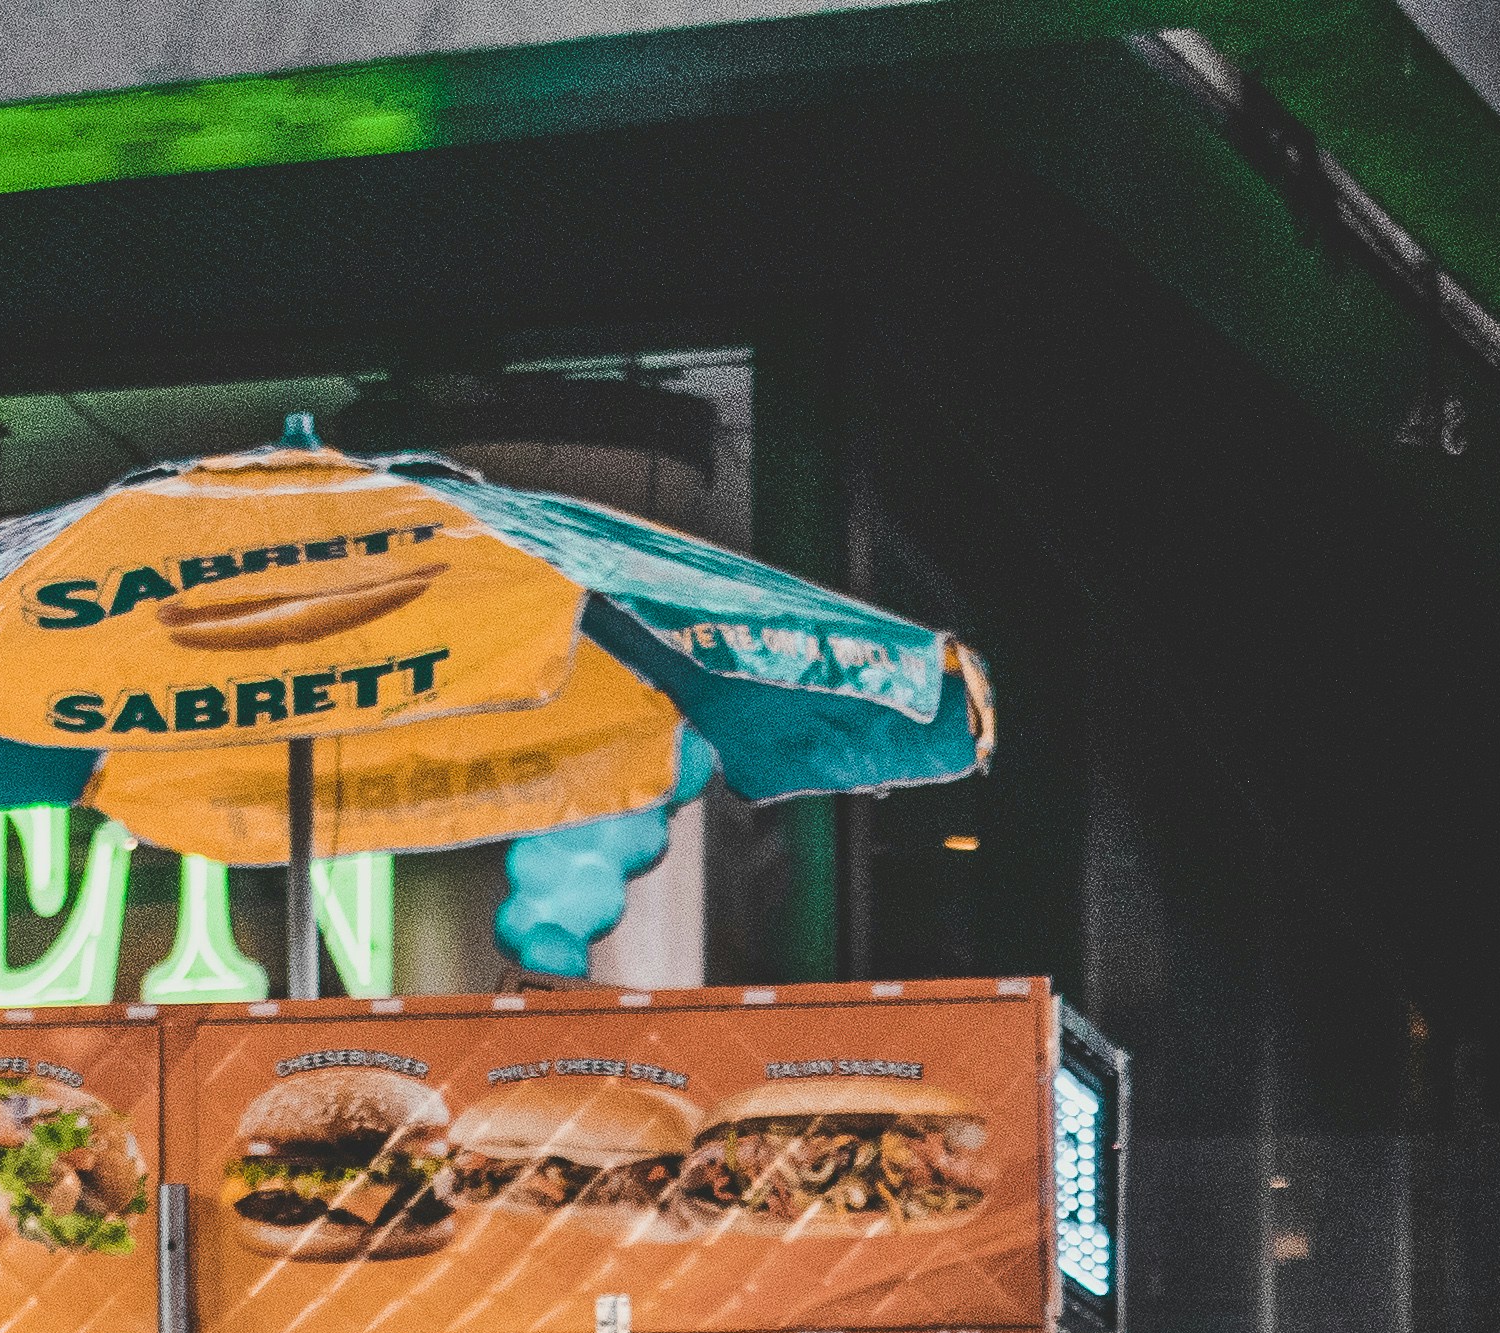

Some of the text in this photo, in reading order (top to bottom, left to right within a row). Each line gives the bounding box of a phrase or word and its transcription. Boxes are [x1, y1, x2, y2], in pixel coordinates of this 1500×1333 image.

[21, 523, 443, 629] SABRETT
[47, 646, 449, 733] SABRETT
[36, 1060, 82, 1087] GYRO
[275, 1049, 427, 1077] CHEESEBURGER
[487, 1059, 689, 1089] PHILLY CHEESE STEAK
[766, 1059, 923, 1080] ITALIAN SAUSAGE
